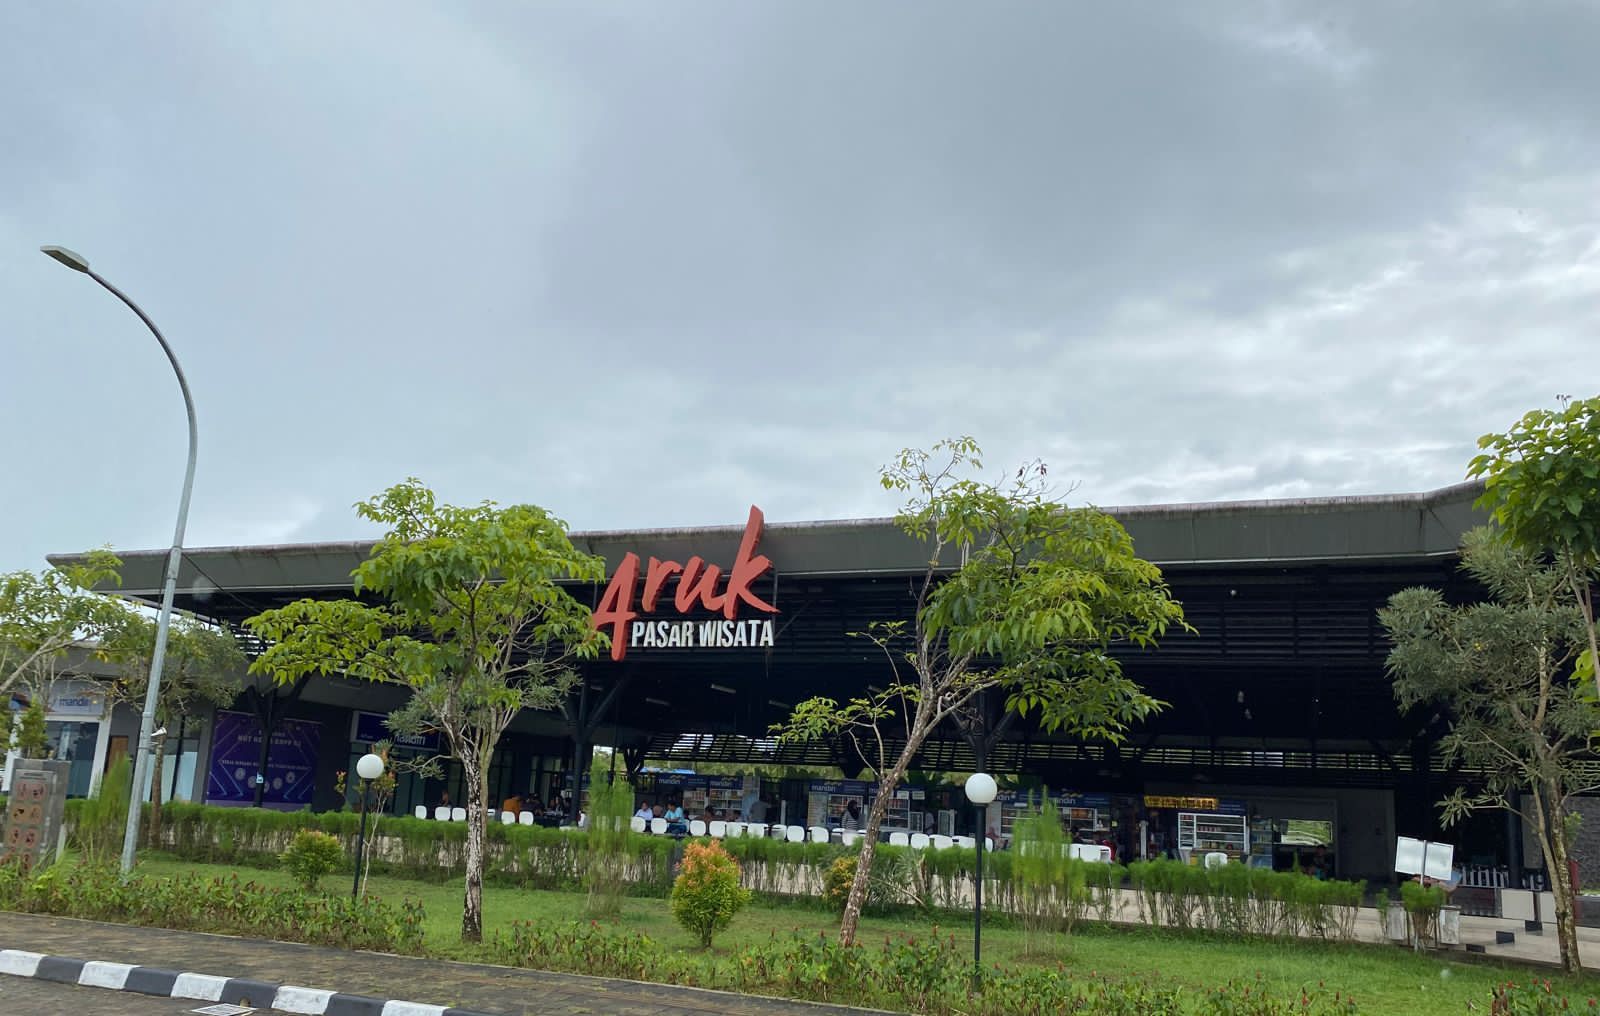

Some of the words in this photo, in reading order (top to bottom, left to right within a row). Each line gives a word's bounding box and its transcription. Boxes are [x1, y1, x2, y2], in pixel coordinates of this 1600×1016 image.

[592, 504, 781, 661] Aruk
[632, 620, 694, 648] PASAR
[699, 620, 774, 647] WISATA
